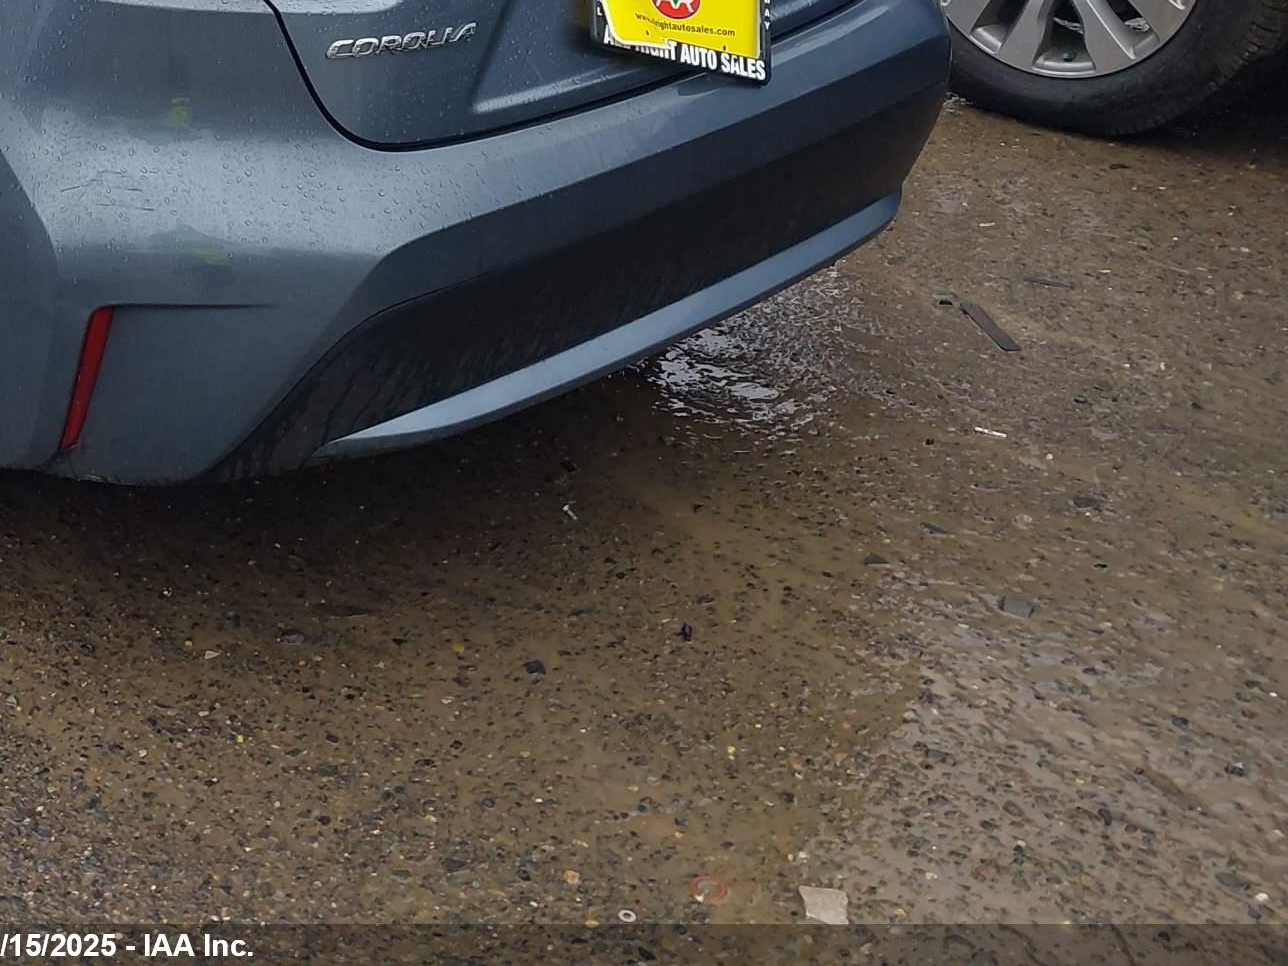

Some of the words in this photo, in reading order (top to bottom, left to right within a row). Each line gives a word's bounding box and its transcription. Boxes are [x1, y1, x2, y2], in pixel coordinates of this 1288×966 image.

[326, 22, 478, 59] COROLLA
[680, 43, 718, 71] AUTO
[720, 52, 767, 81] SALES
